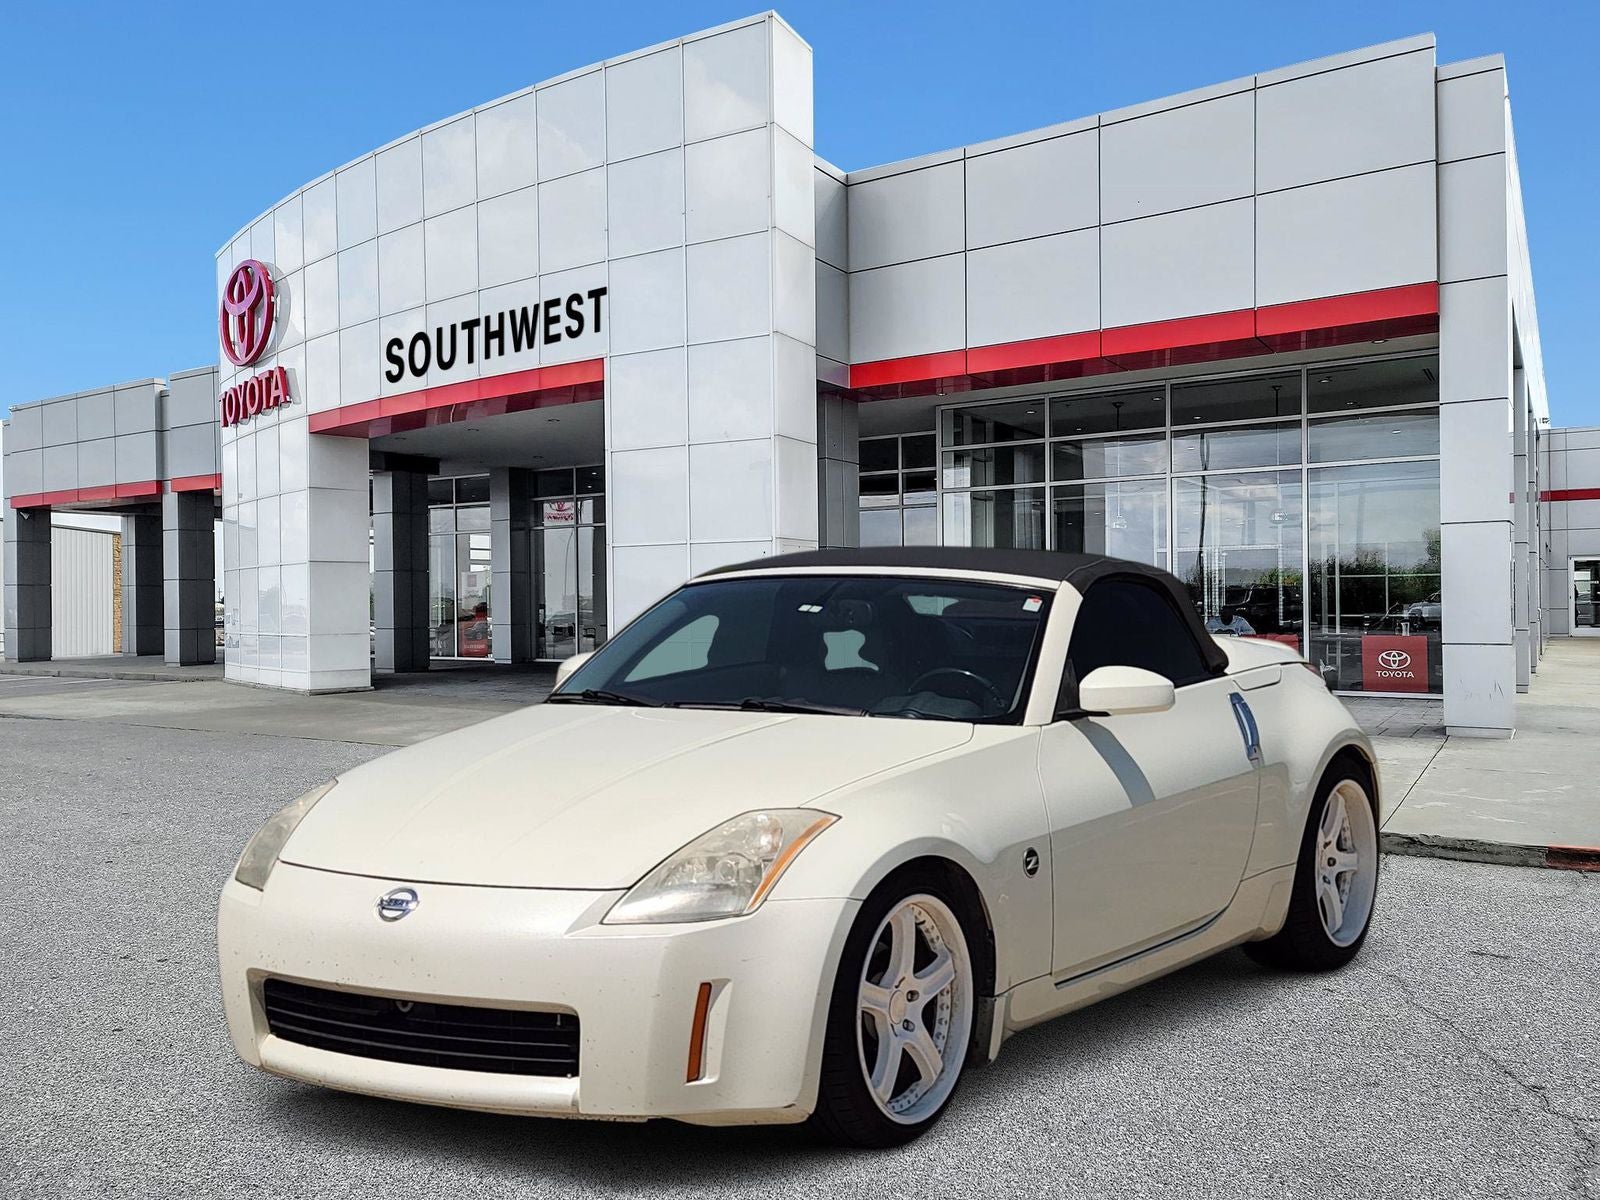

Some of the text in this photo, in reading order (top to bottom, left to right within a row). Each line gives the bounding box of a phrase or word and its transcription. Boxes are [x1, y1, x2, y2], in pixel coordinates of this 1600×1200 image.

[385, 286, 608, 384] SOUTHWEST
[219, 366, 290, 428] TOYOTA
[1376, 670, 1415, 678] TOYOTA
[1026, 855, 1039, 870] Z
